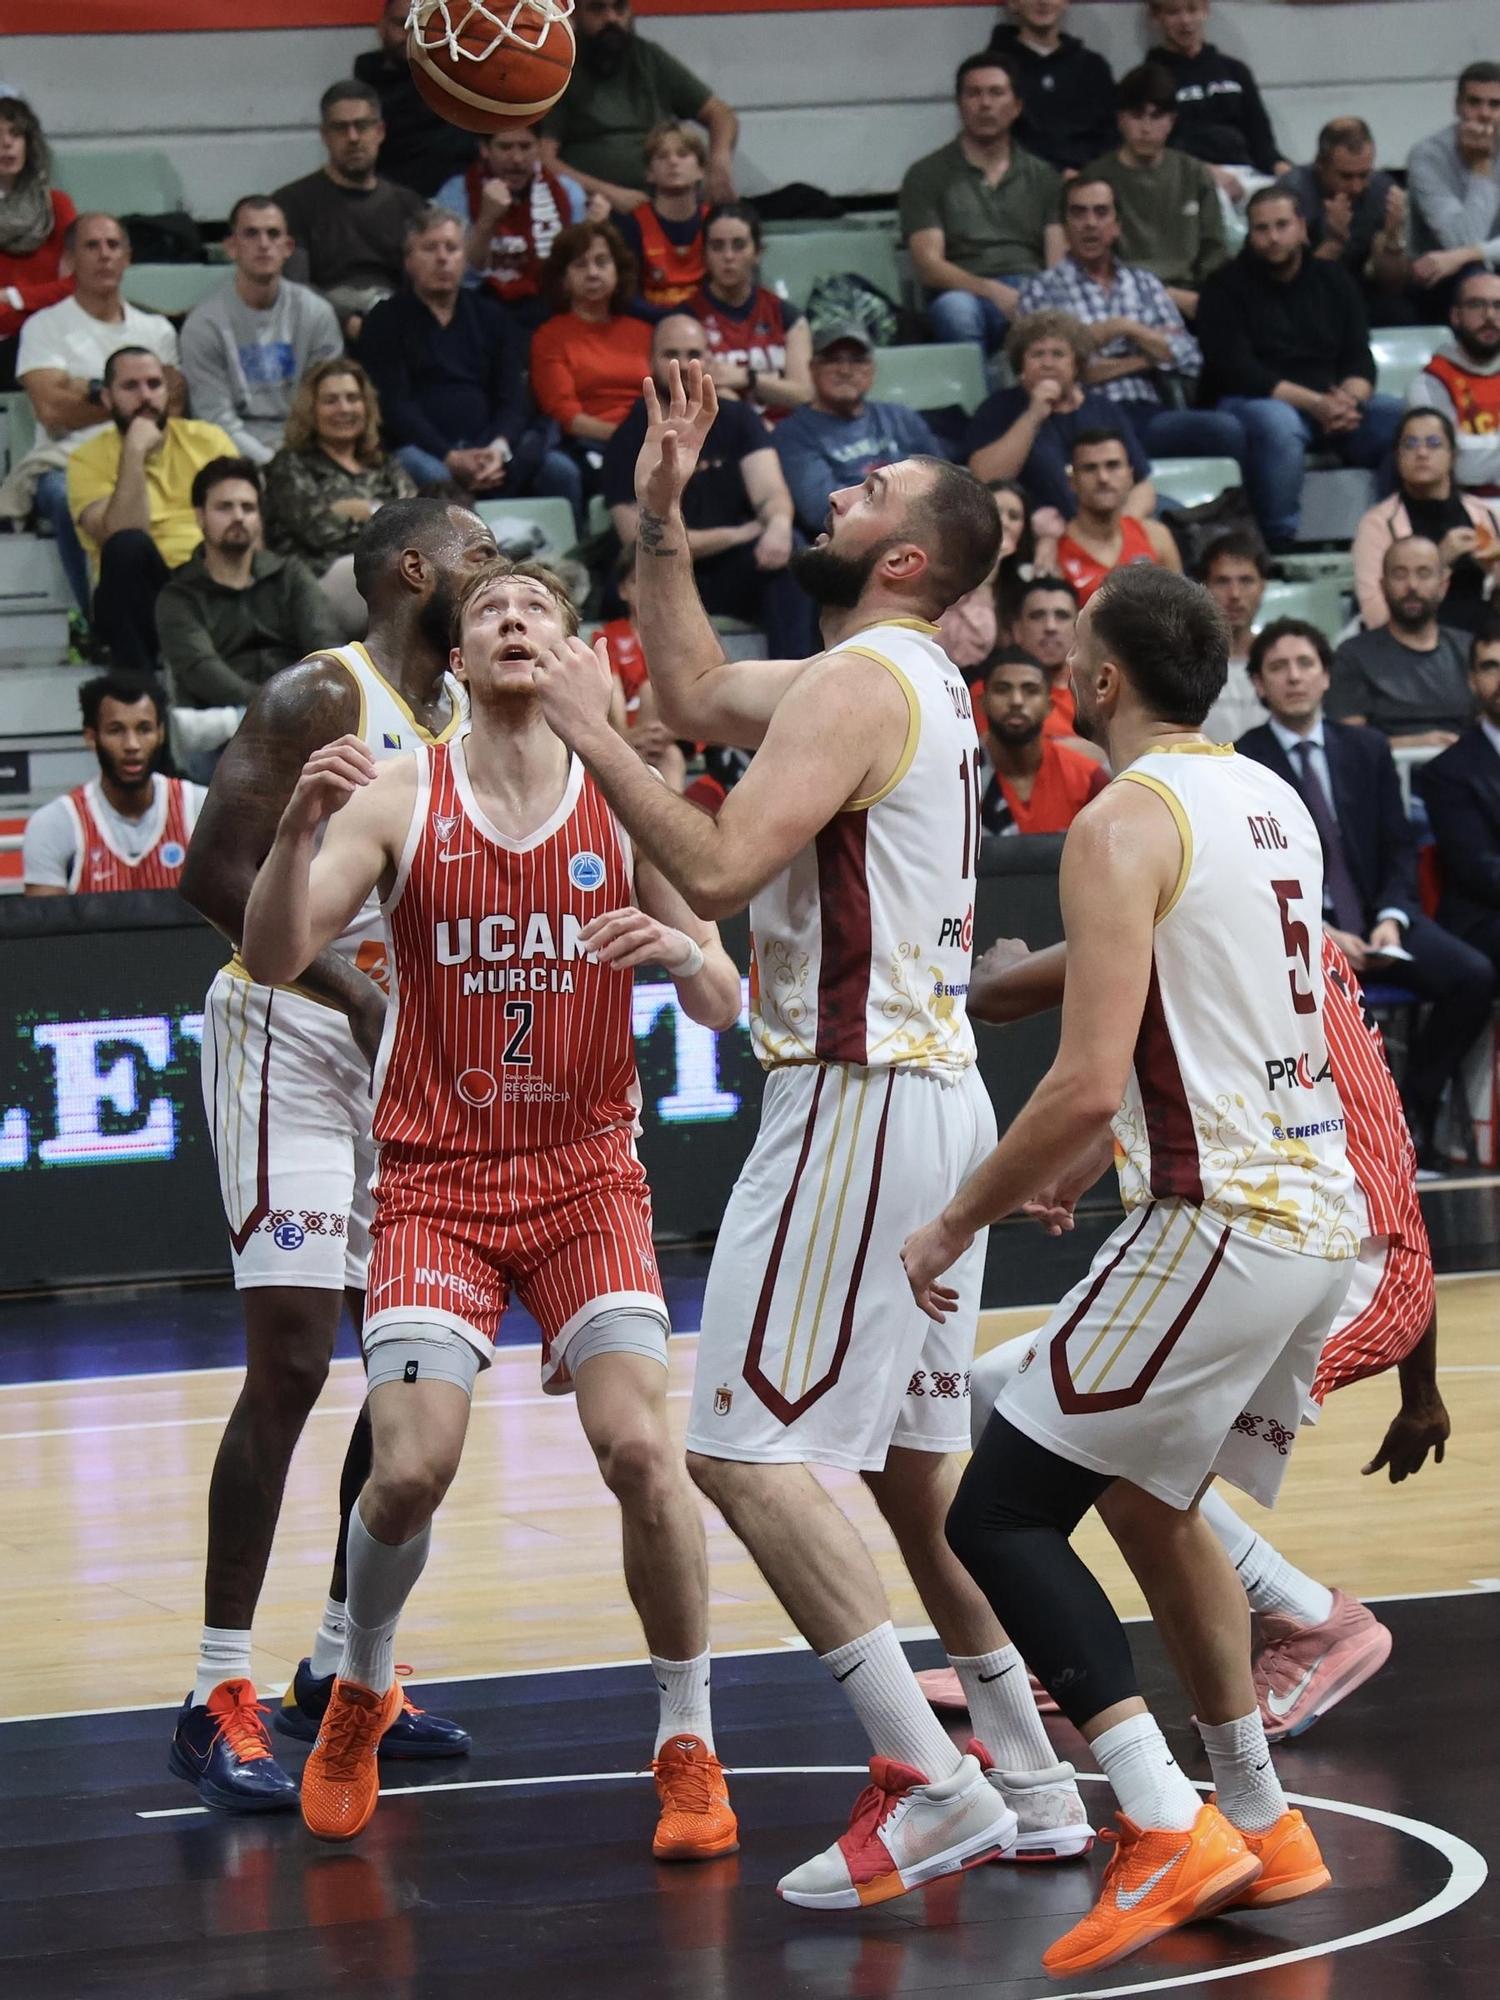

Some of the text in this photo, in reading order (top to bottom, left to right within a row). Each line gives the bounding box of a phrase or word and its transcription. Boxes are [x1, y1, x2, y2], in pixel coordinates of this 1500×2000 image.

[1247, 811, 1288, 849] ATIĆ
[436, 912, 599, 966] UCAM
[1270, 880, 1317, 1014] 5
[463, 967, 575, 996] MURCIA
[501, 1000, 534, 1066] 2
[504, 1080, 552, 1092] REGIÓN
[504, 1092, 571, 1103] DE MURCIA
